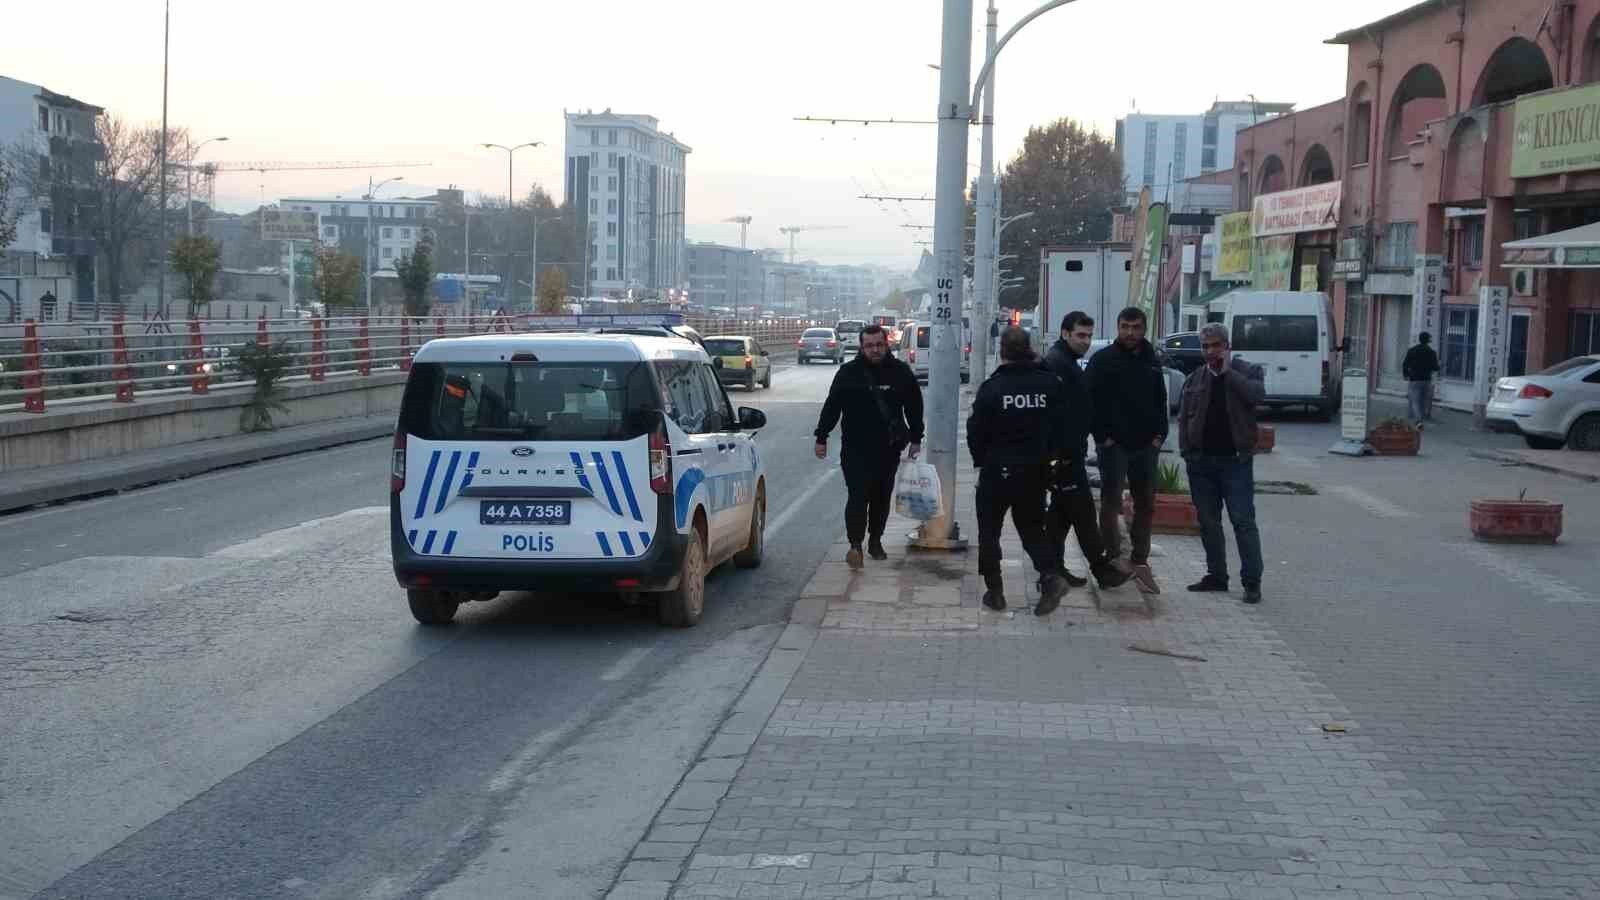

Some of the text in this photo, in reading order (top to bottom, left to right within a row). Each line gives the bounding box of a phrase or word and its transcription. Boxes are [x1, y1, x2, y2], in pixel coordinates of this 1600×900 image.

[937, 293, 949, 303] 11
[1002, 394, 1047, 409] POLİS
[486, 505, 564, 518] 44 A 7358
[503, 532, 554, 552] POLİS
